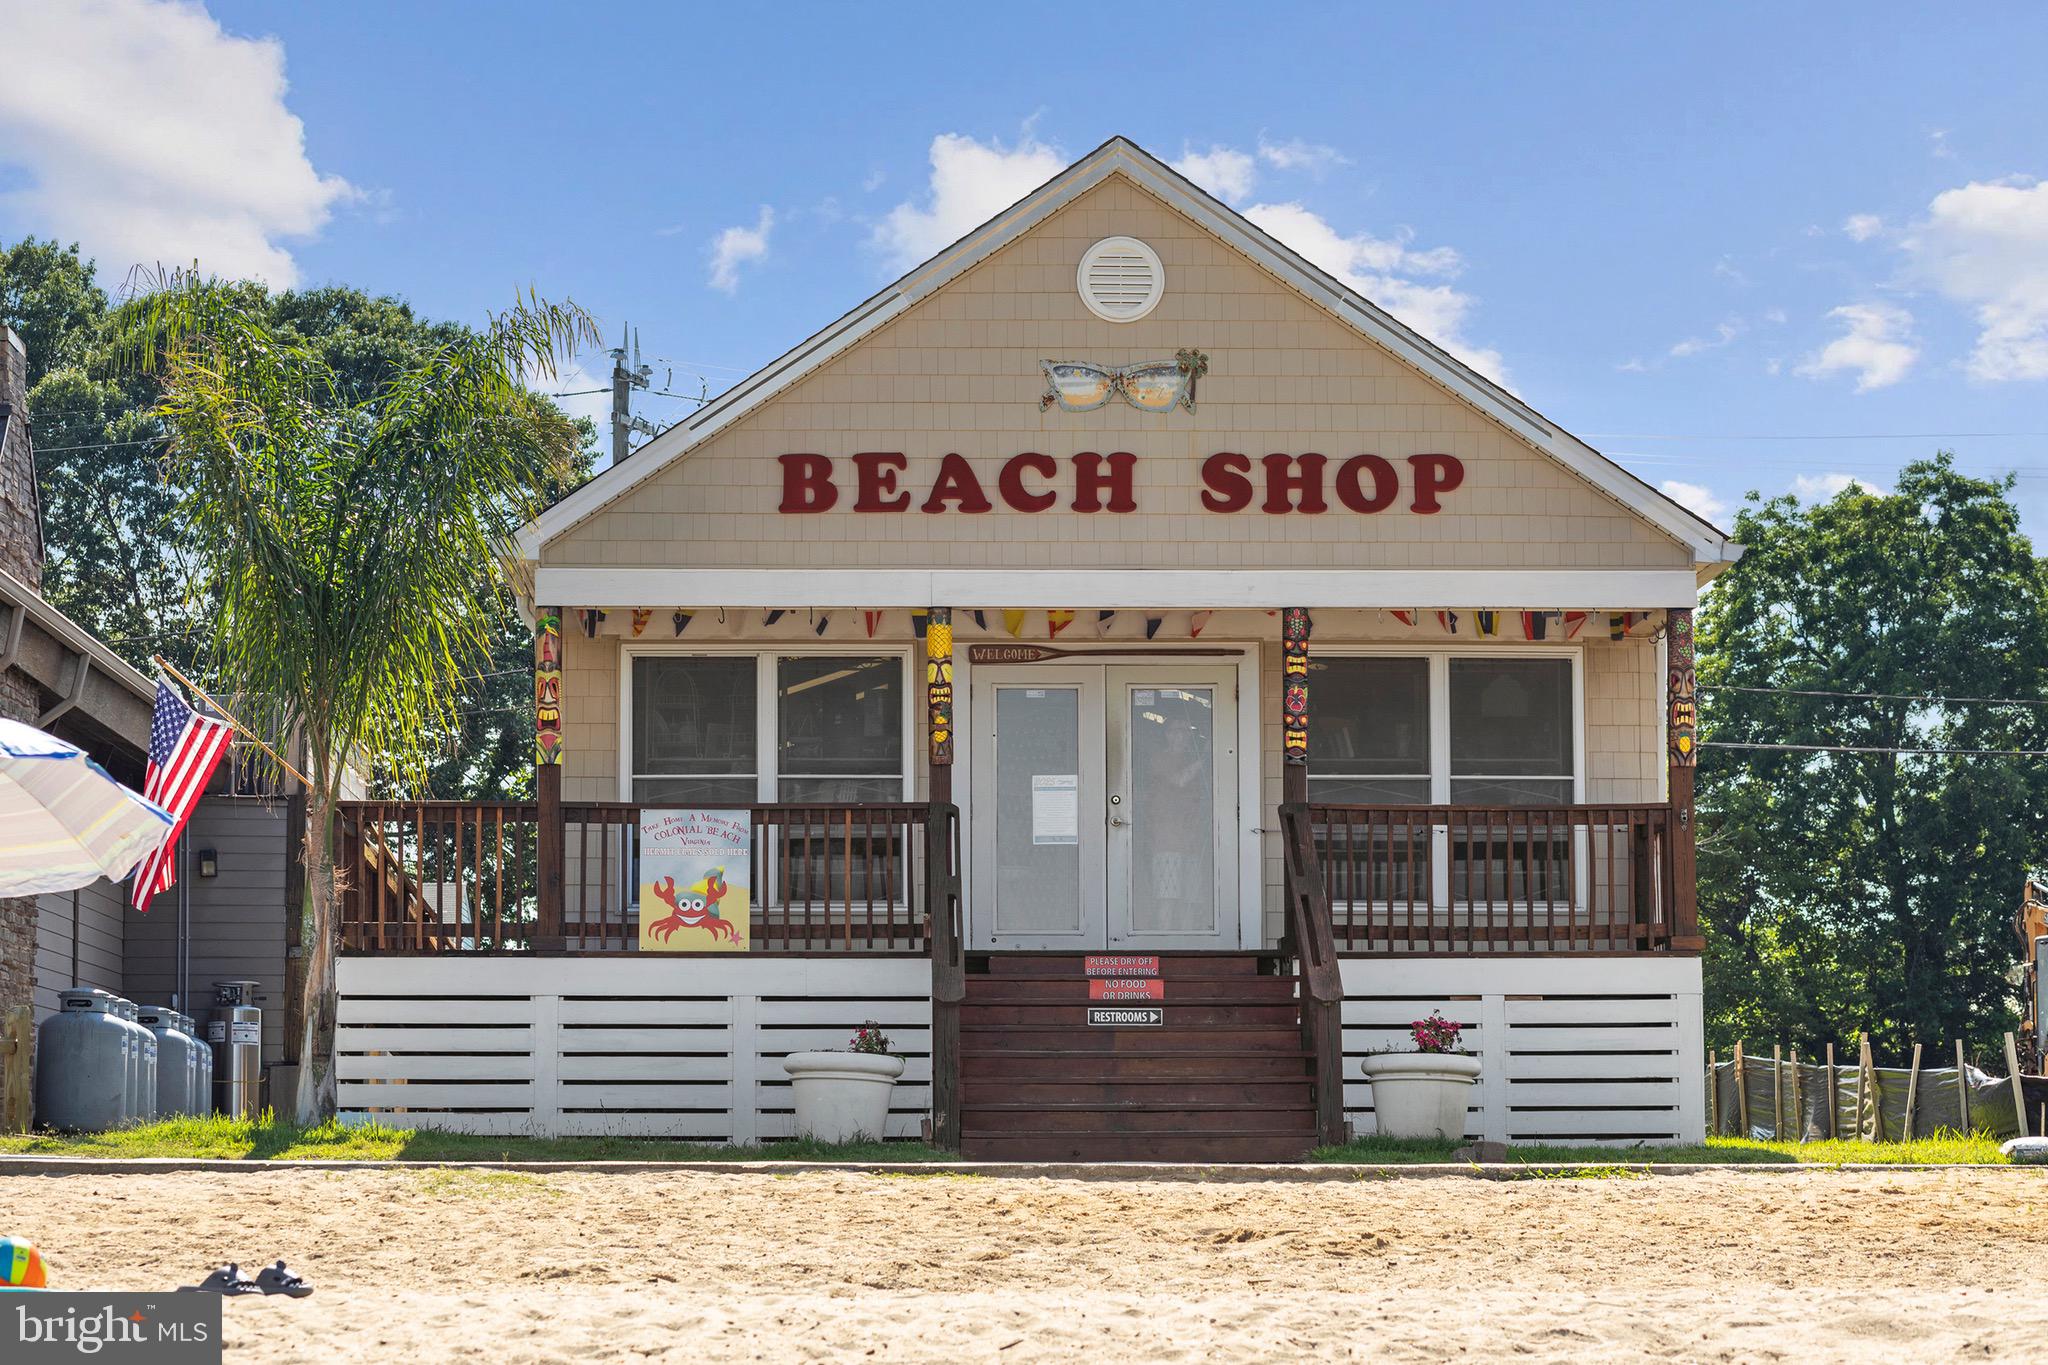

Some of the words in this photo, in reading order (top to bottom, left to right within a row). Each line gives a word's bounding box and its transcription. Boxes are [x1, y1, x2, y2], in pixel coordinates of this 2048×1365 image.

[778, 452, 1137, 514] BEACH
[1200, 452, 1465, 514] SHOP
[973, 648, 1036, 660] WELCOME
[654, 825, 702, 841] COLONIAL
[707, 826, 741, 844] BEACH
[1090, 957, 1118, 966] PLEASE
[1120, 957, 1137, 965] DRY
[1138, 957, 1153, 965] OFF
[1086, 967, 1116, 976] BEFORE
[1118, 967, 1157, 976] ENTERING
[1105, 980, 1119, 988] NO
[1120, 980, 1146, 988] FOOD
[1102, 991, 1115, 1000] OR
[1117, 991, 1151, 1000] DRINKS
[1094, 1011, 1148, 1023] RESTROOMS
